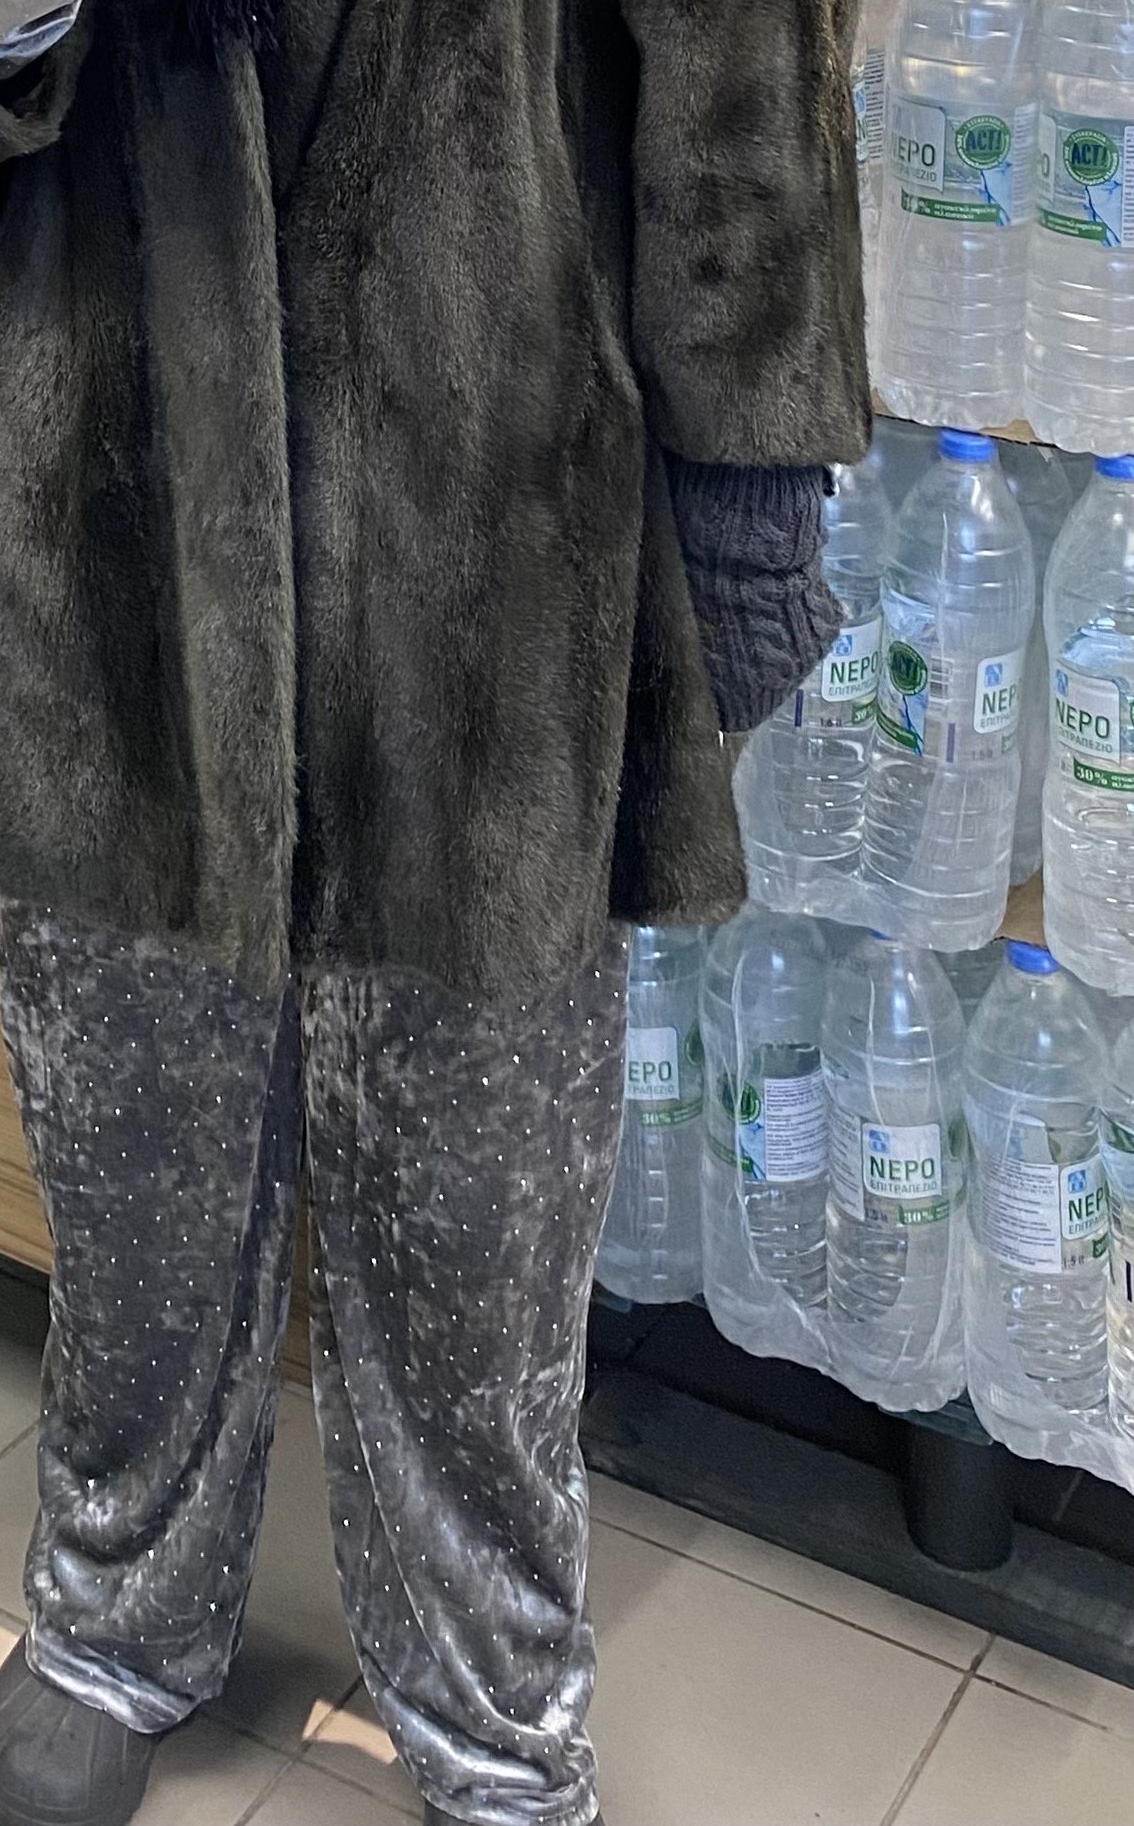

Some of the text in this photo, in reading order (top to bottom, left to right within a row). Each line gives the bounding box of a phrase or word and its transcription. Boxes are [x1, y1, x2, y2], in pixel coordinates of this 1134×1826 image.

[966, 129, 1003, 152] ACT!
[982, 684, 1017, 715] ΝΕΡ
[1056, 697, 1110, 739] ΝΕΡΟ
[628, 1060, 672, 1084] ΕΡΟ
[869, 1155, 935, 1181] ΝΕΡΟ
[1068, 1187, 1104, 1222] ΝΕΡ
